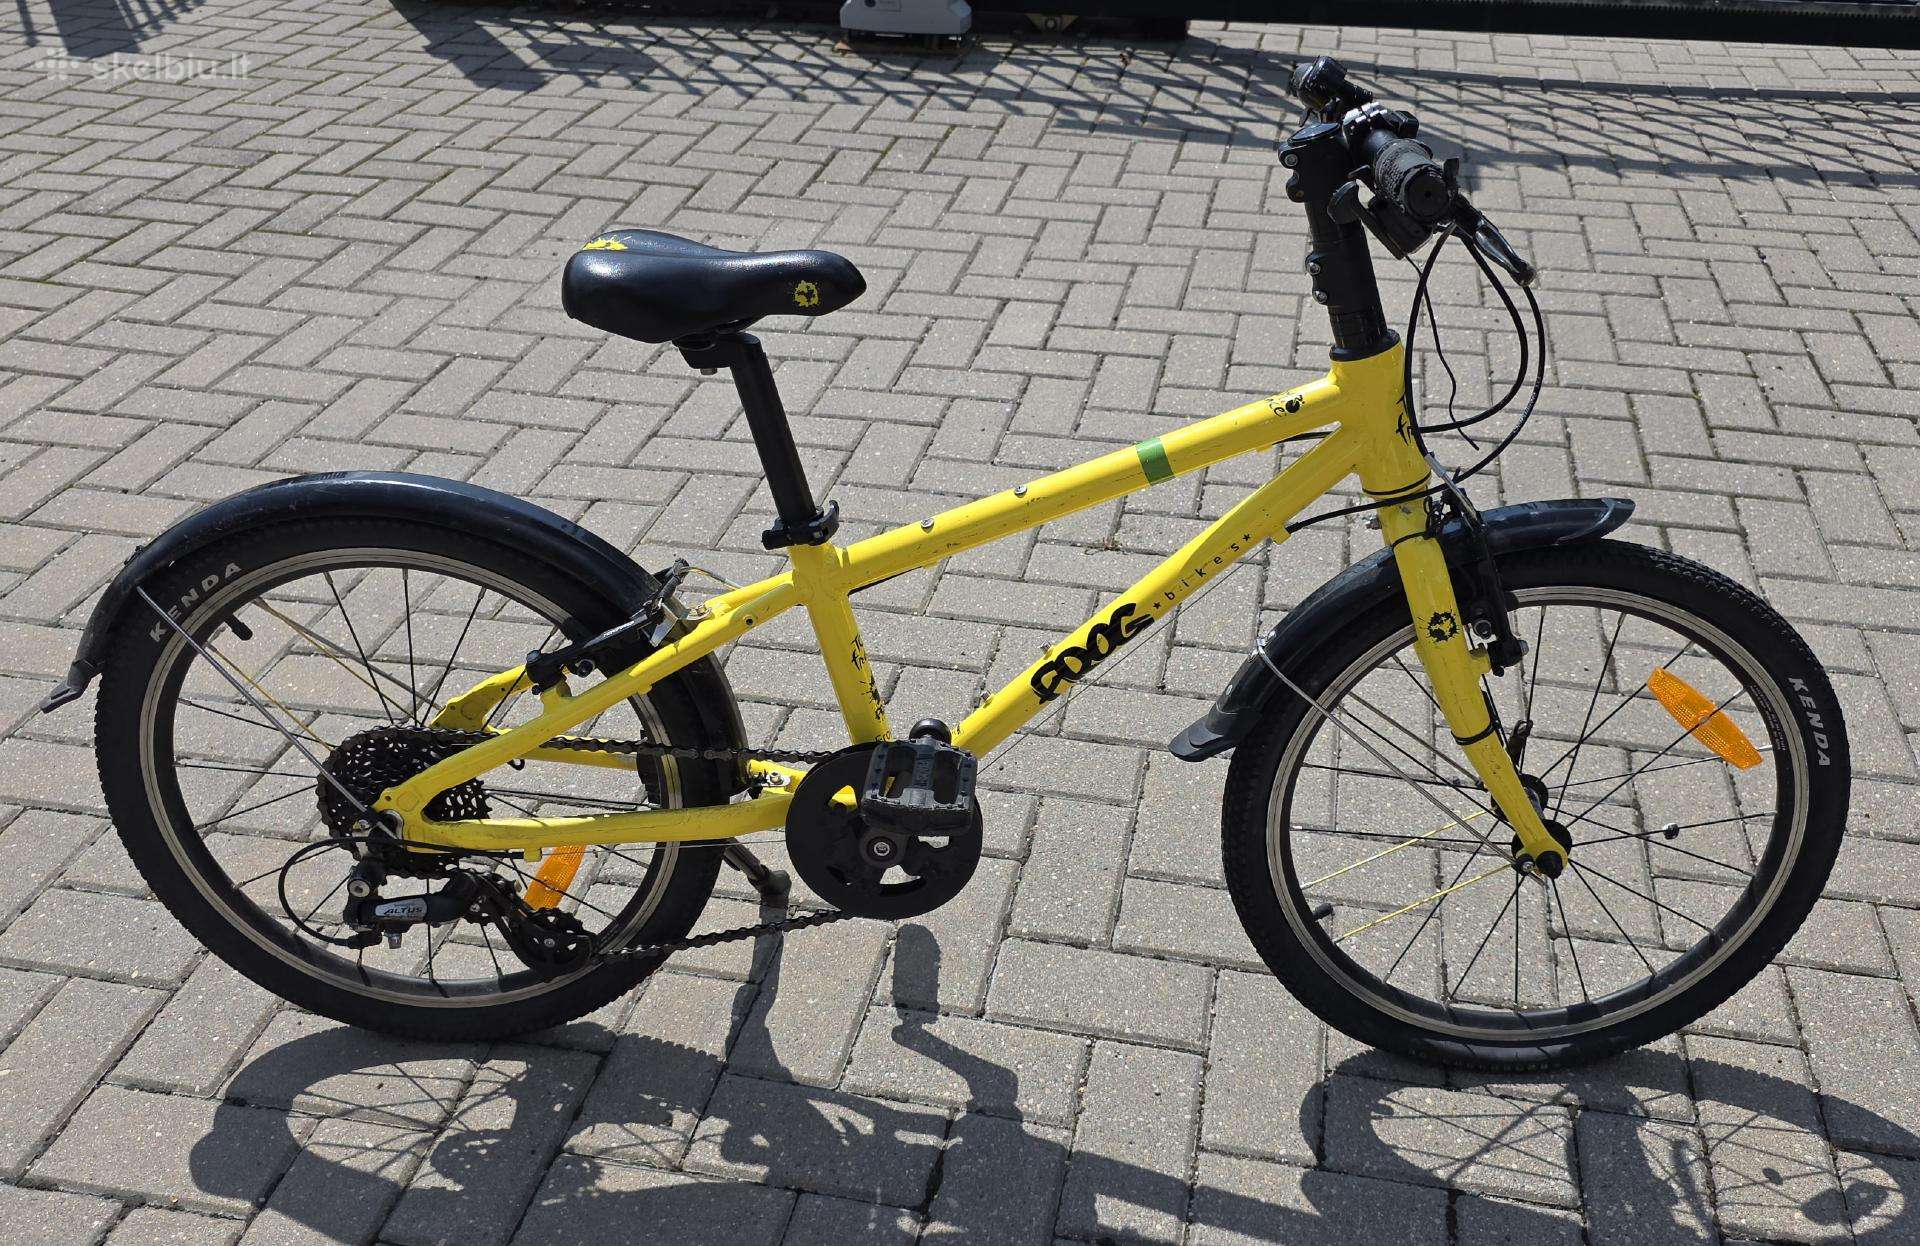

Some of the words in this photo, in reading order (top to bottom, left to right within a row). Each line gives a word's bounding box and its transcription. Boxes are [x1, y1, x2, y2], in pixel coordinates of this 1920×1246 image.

[149, 562, 242, 642] KENDA
[1164, 542, 1240, 601] bikes
[1788, 677, 1830, 766] KENDA
[384, 906, 422, 915] ALTUS
